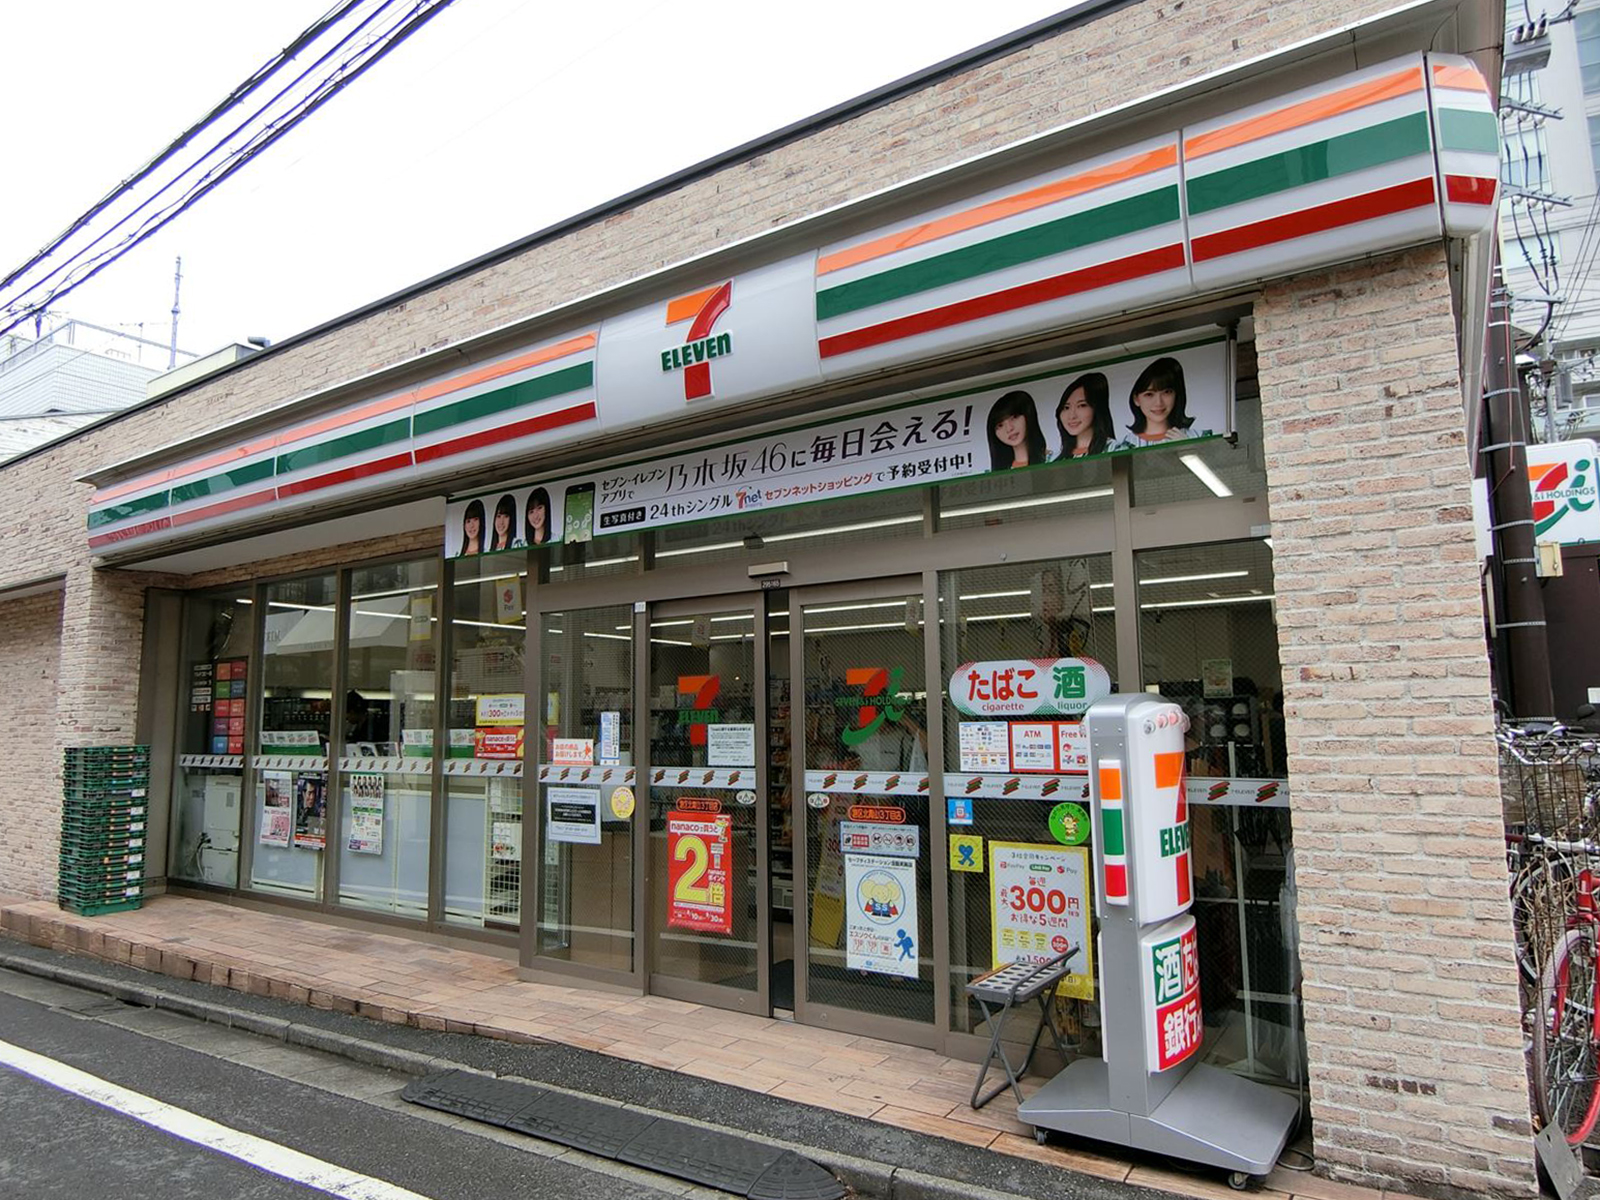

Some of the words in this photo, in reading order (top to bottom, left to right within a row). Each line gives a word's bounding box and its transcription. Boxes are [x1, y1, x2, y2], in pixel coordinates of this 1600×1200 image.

[600, 489, 636, 504] アプリで
[1546, 486, 1595, 499] HOLDINGS
[968, 667, 1039, 701] たばこ
[1053, 666, 1086, 699] 酒
[981, 701, 1025, 713] cigarette
[1023, 730, 1042, 738] ATM
[1010, 885, 1066, 915] 300
[1067, 896, 1079, 910] 円
[1155, 943, 1182, 1002] 酒
[1163, 999, 1197, 1060] 銀行
